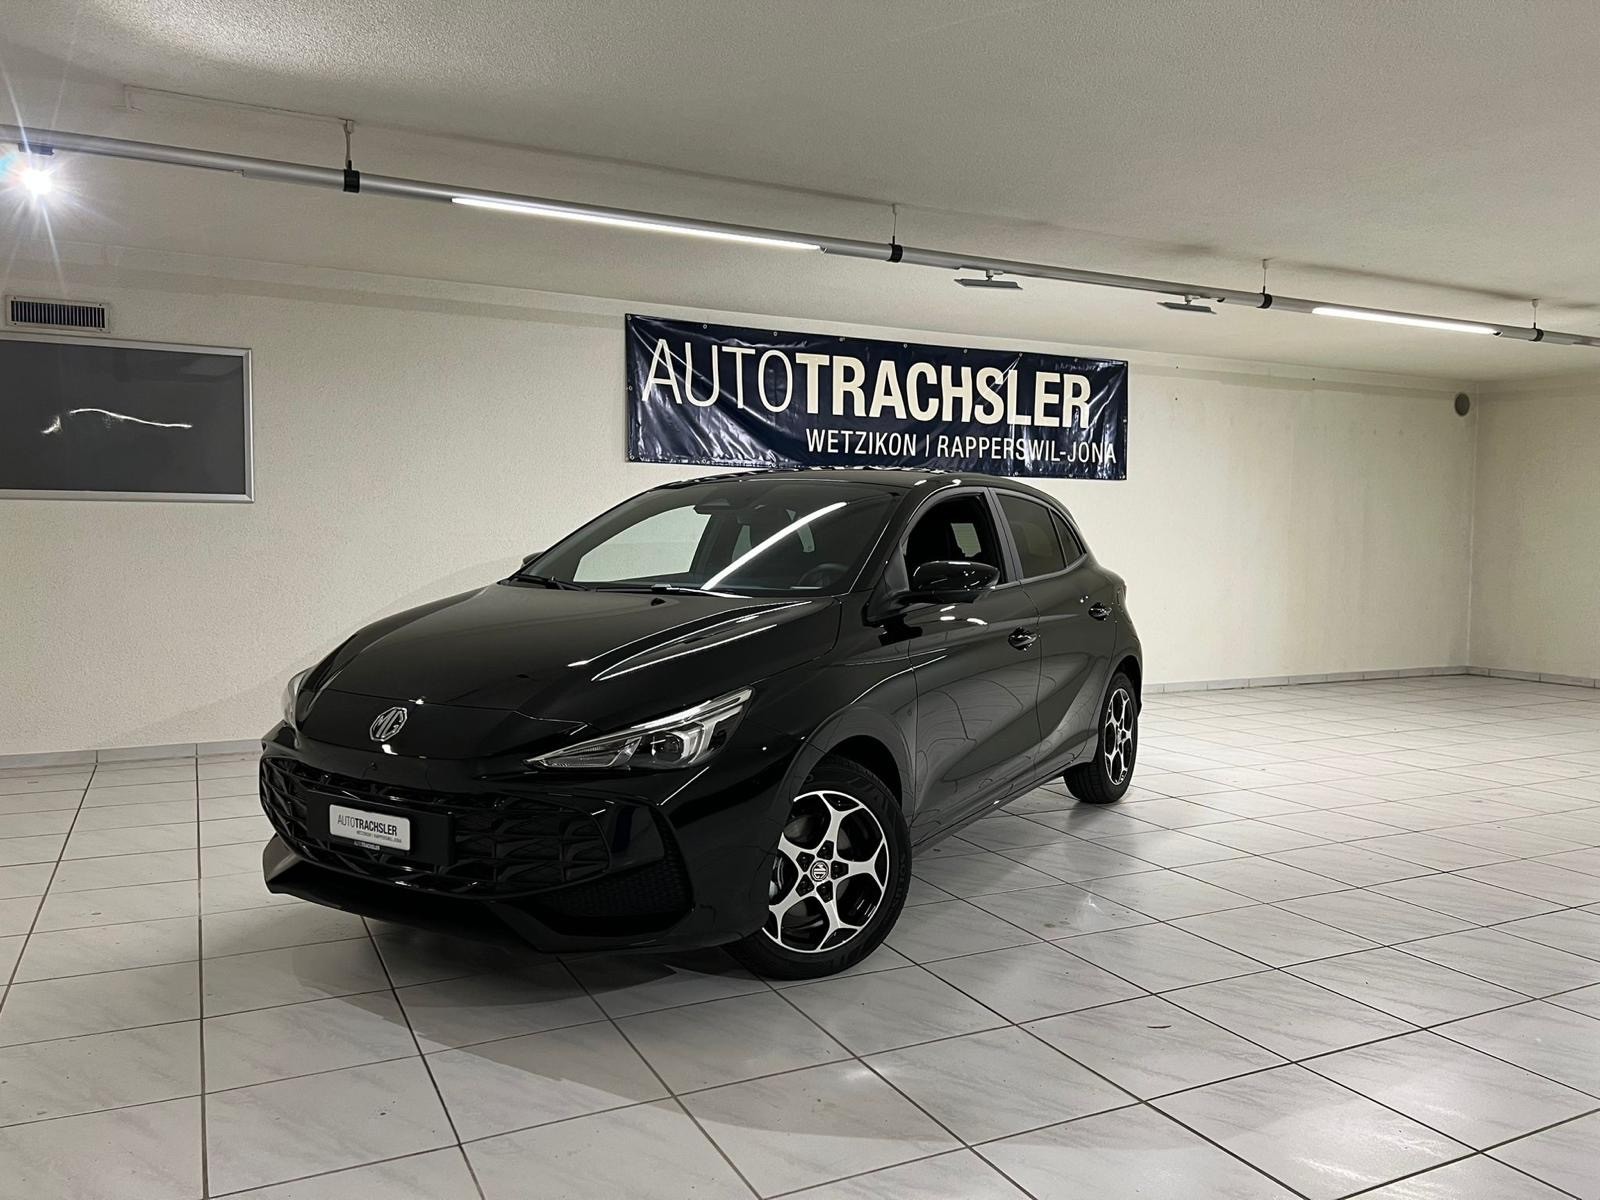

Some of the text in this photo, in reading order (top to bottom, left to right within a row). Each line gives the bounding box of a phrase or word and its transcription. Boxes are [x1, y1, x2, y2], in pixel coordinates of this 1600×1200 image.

[805, 428, 917, 457] WETZIKON
[936, 434, 1118, 464] RAPPERSWIL-JONA
[372, 708, 404, 739] MG
